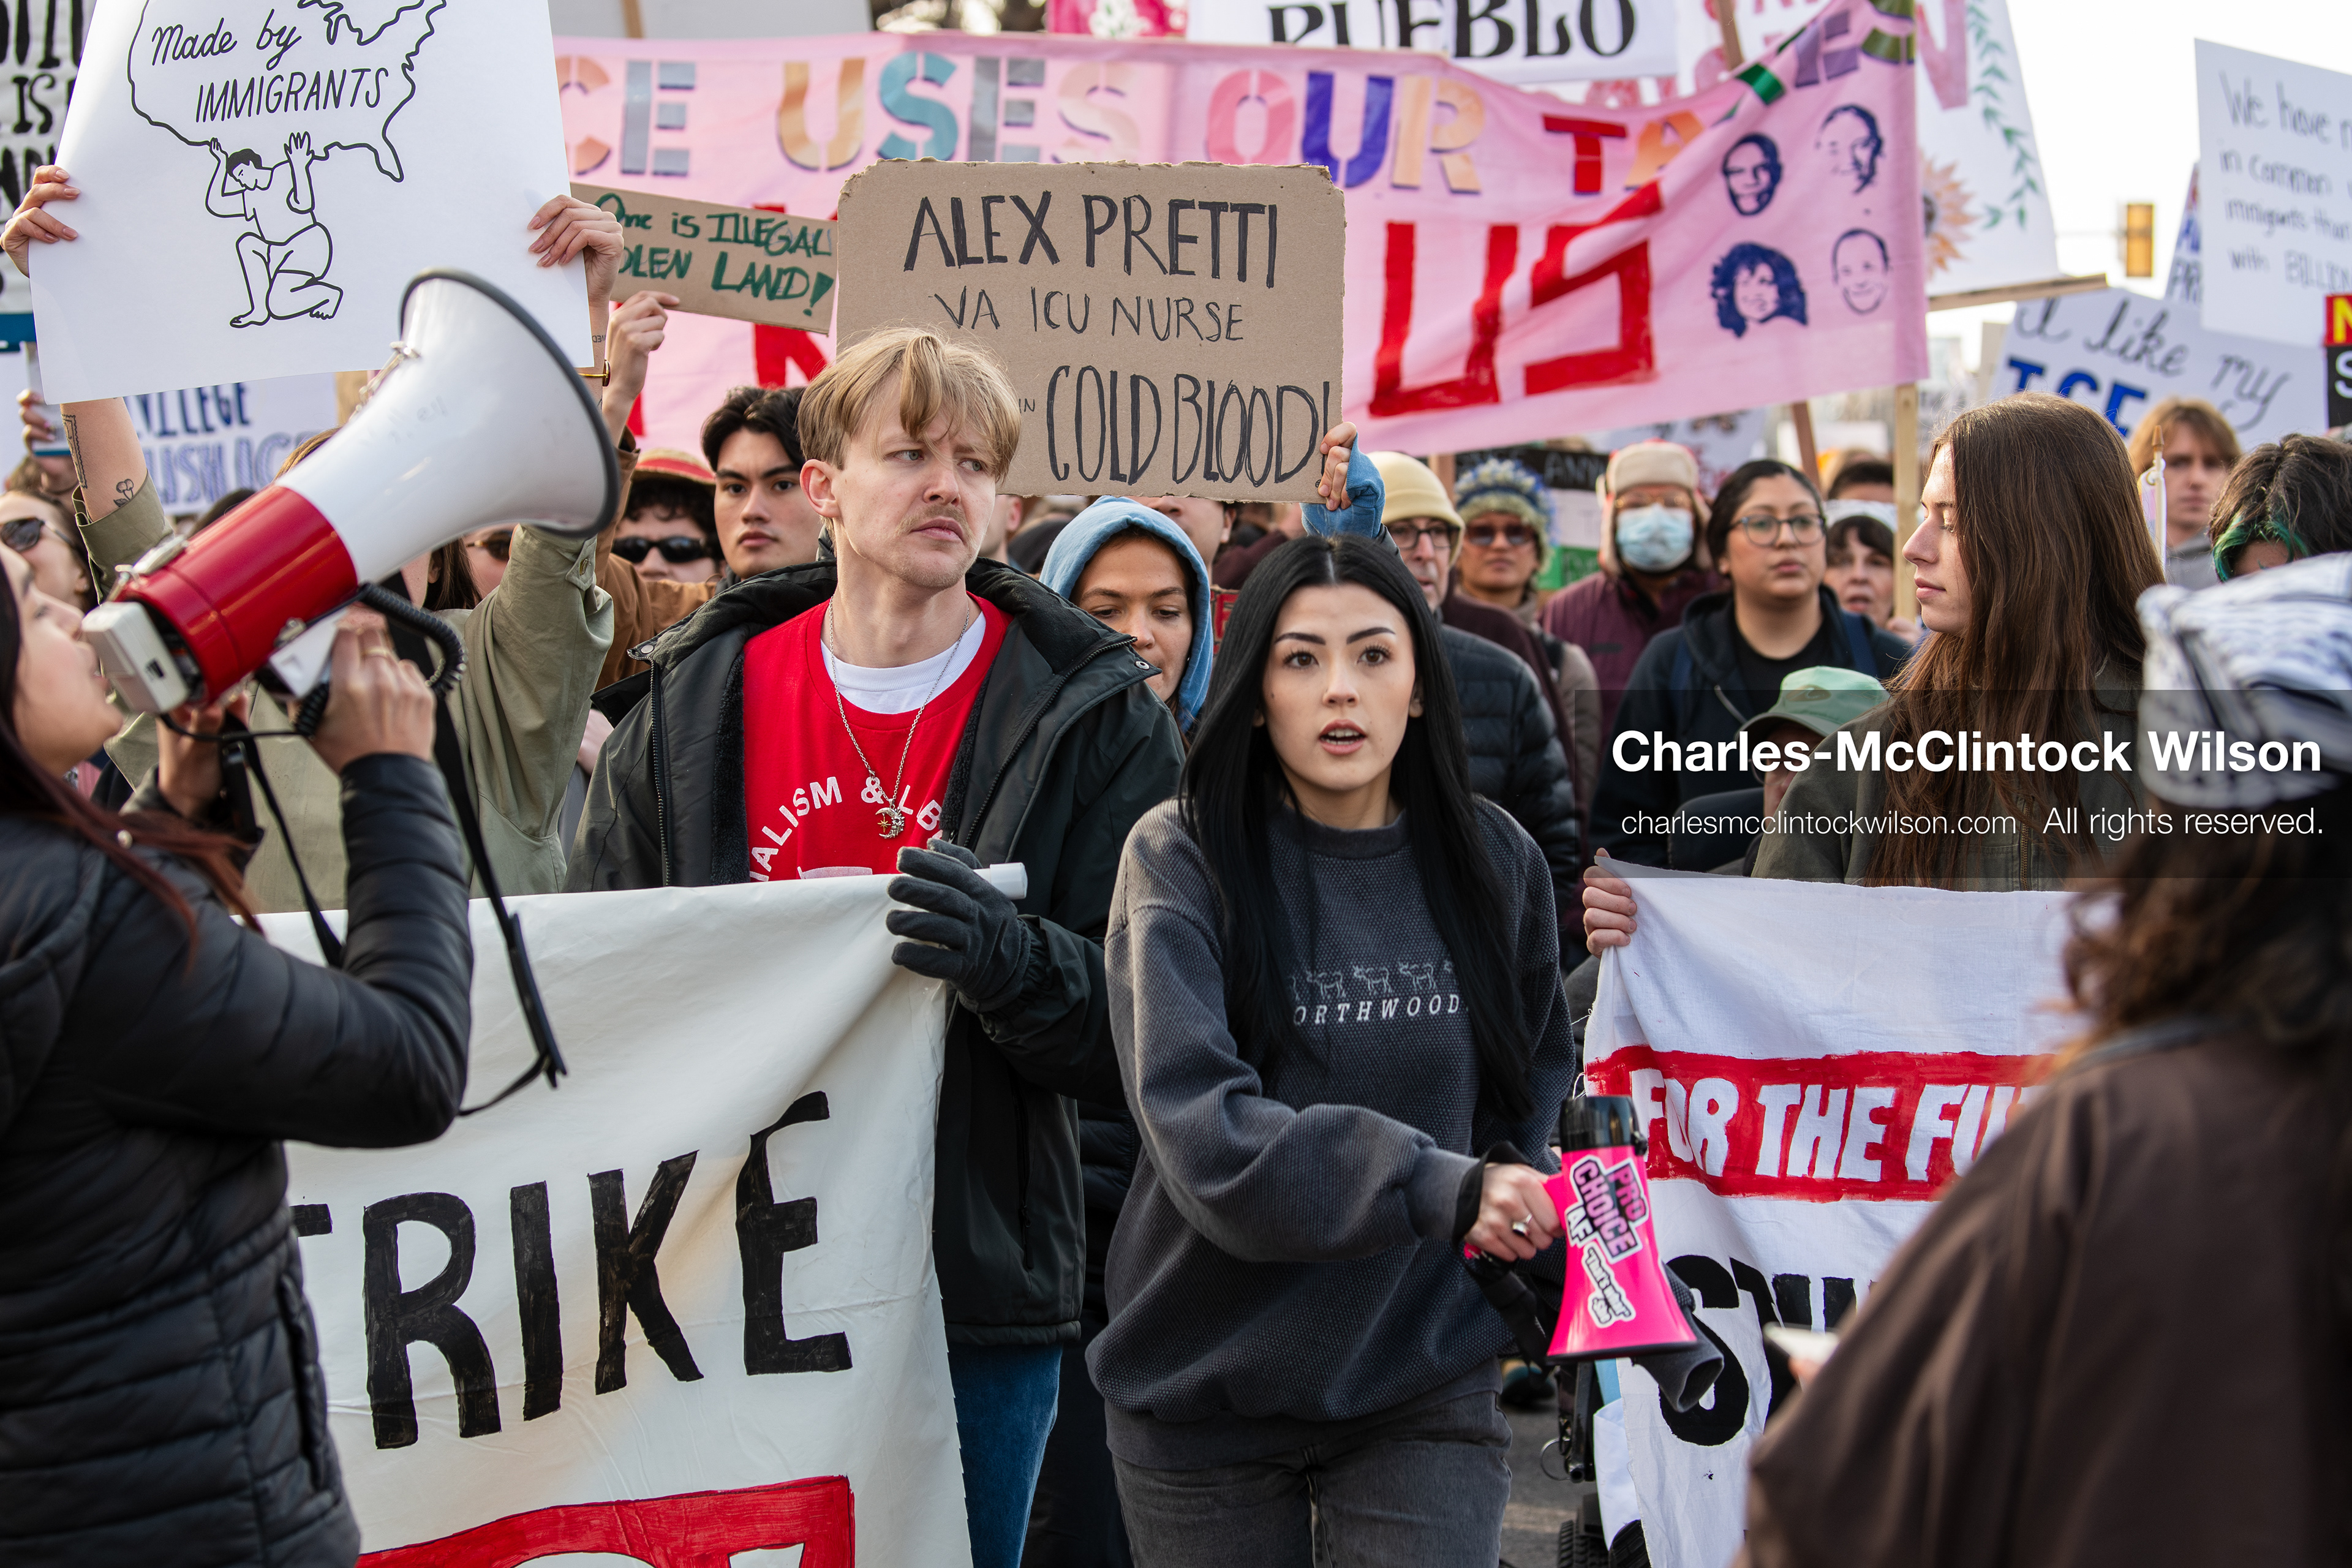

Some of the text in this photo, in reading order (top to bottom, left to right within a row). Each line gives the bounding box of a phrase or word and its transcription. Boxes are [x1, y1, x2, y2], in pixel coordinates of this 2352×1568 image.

[152, 17, 238, 66] Made
[255, 9, 302, 70] by
[195, 67, 389, 123] IMMIGRANTS
[777, 51, 1140, 173] USES
[1205, 69, 1485, 194] OUR
[2218, 69, 2269, 130] We
[2276, 80, 2332, 145] have
[671, 212, 701, 238] is
[903, 190, 1277, 289] ALEX PRETTI
[710, 251, 834, 317] LAND!
[929, 286, 1244, 342] VA ICU NURSE
[2084, 298, 2189, 376] like
[2210, 354, 2293, 432] my
[1019, 366, 1330, 488] IN COLD BLOOD!
[1757, 1084, 1895, 1182] THE
[1566, 1204, 1594, 1244] AF
[1572, 1159, 1638, 1258] CHOICE
[1611, 1163, 1648, 1222] PRO
